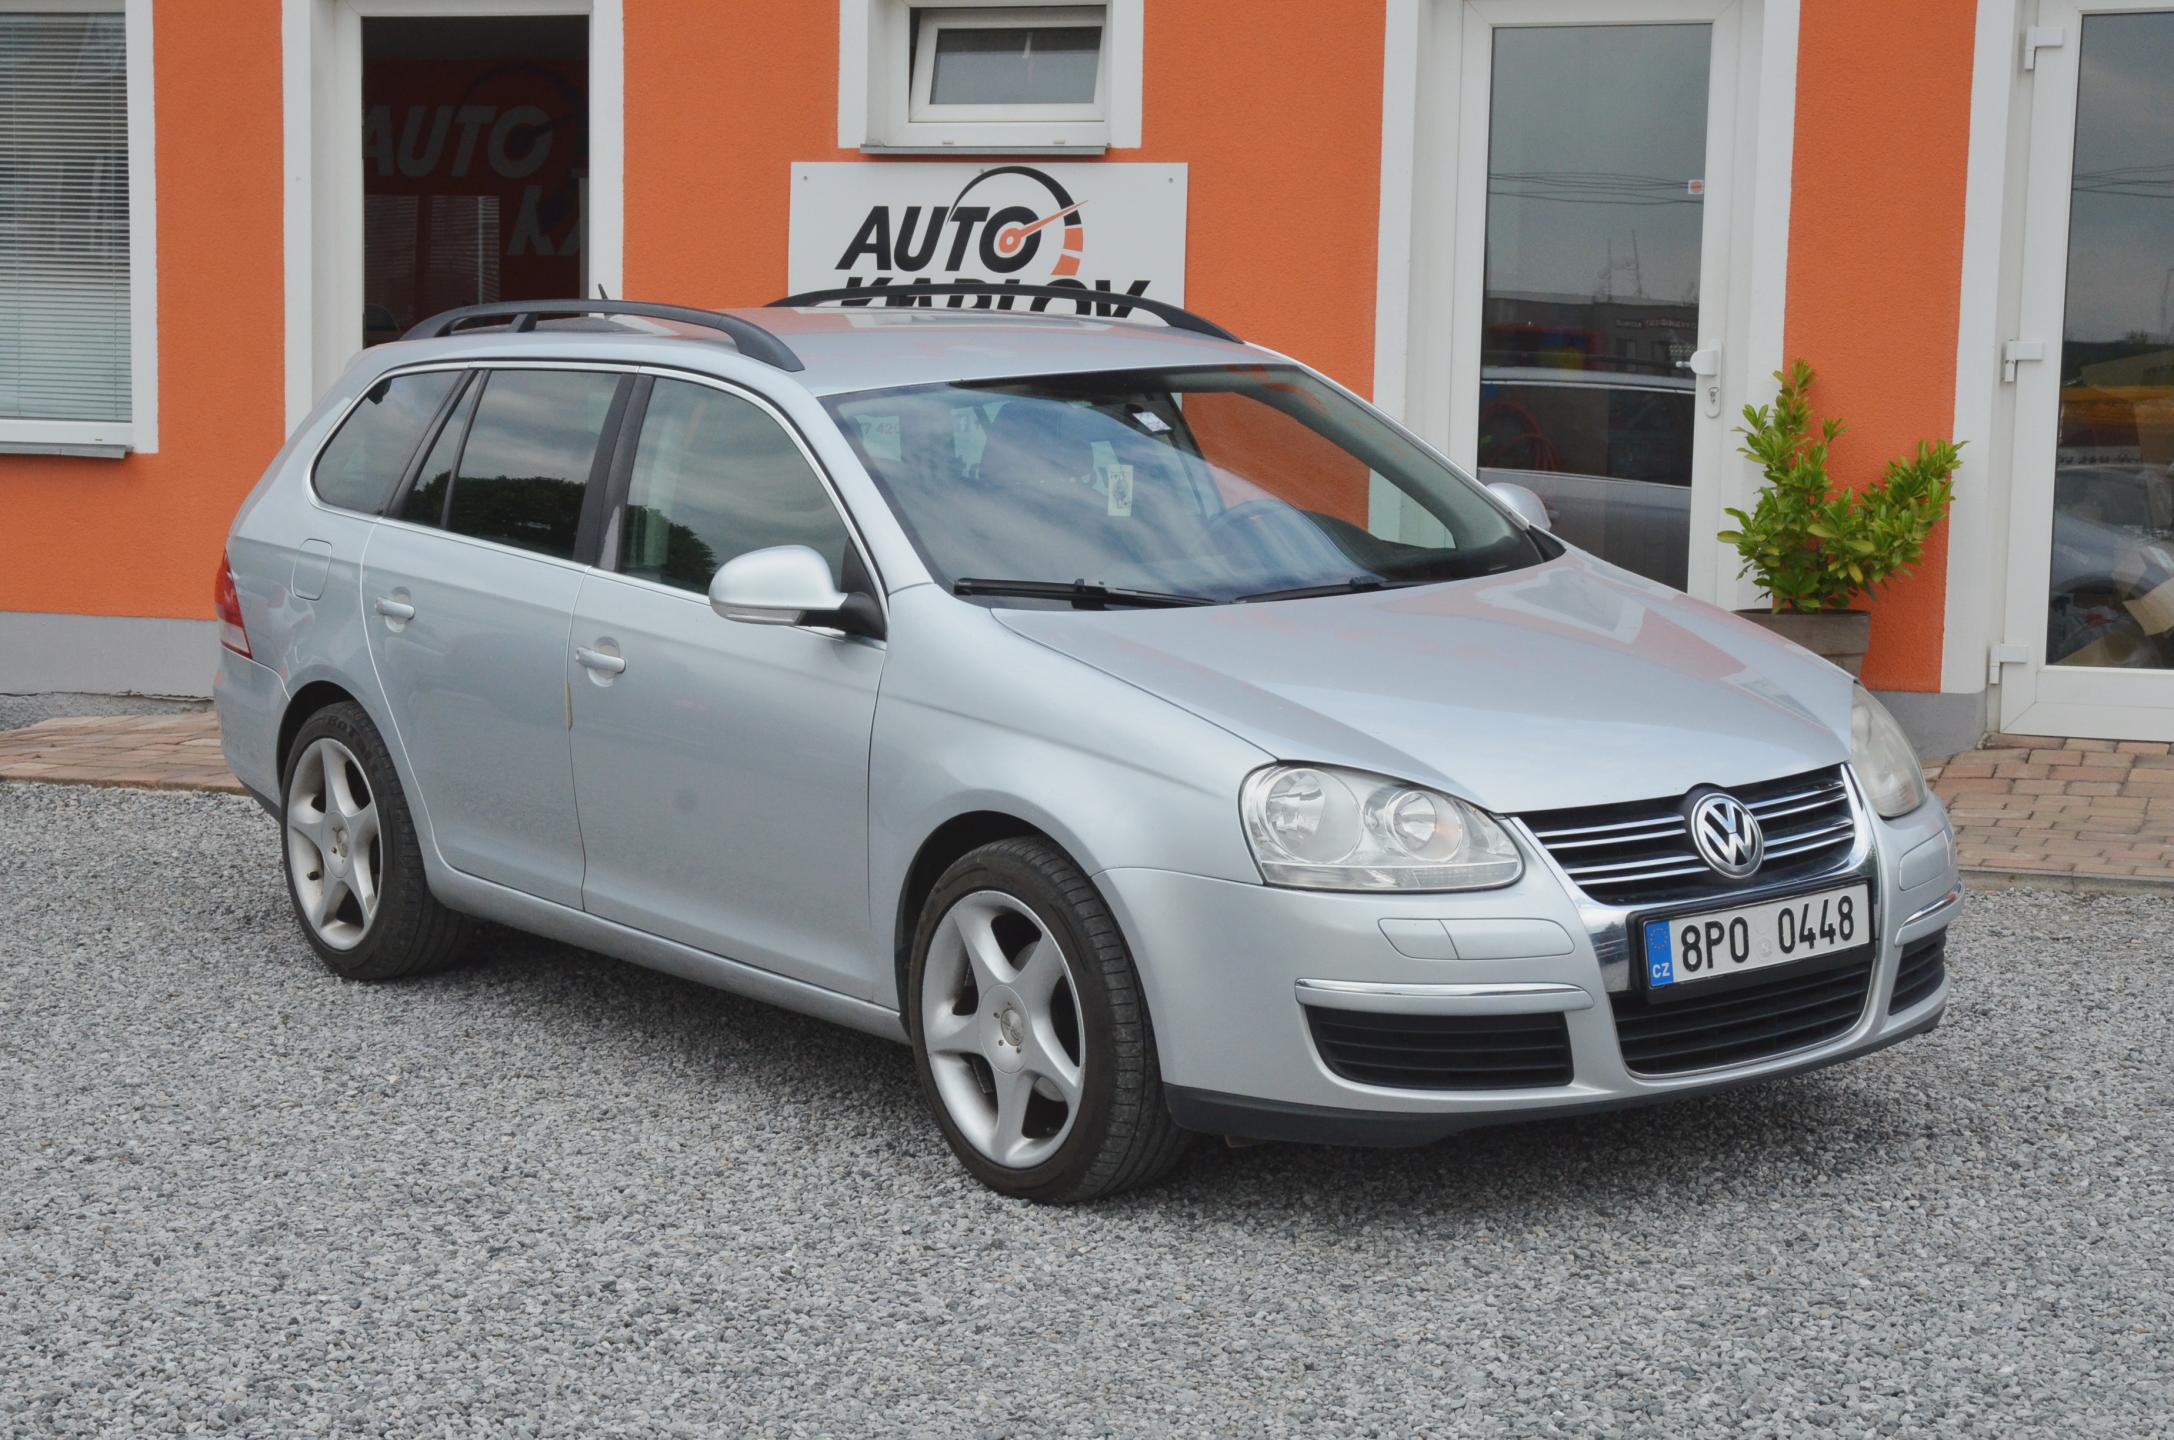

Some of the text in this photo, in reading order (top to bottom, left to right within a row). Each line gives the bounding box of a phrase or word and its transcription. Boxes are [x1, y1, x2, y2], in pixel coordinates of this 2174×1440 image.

[835, 205, 1042, 273] AUTO
[1681, 895, 1854, 972] 8P0 0448
[1652, 962, 1671, 978] CZ
